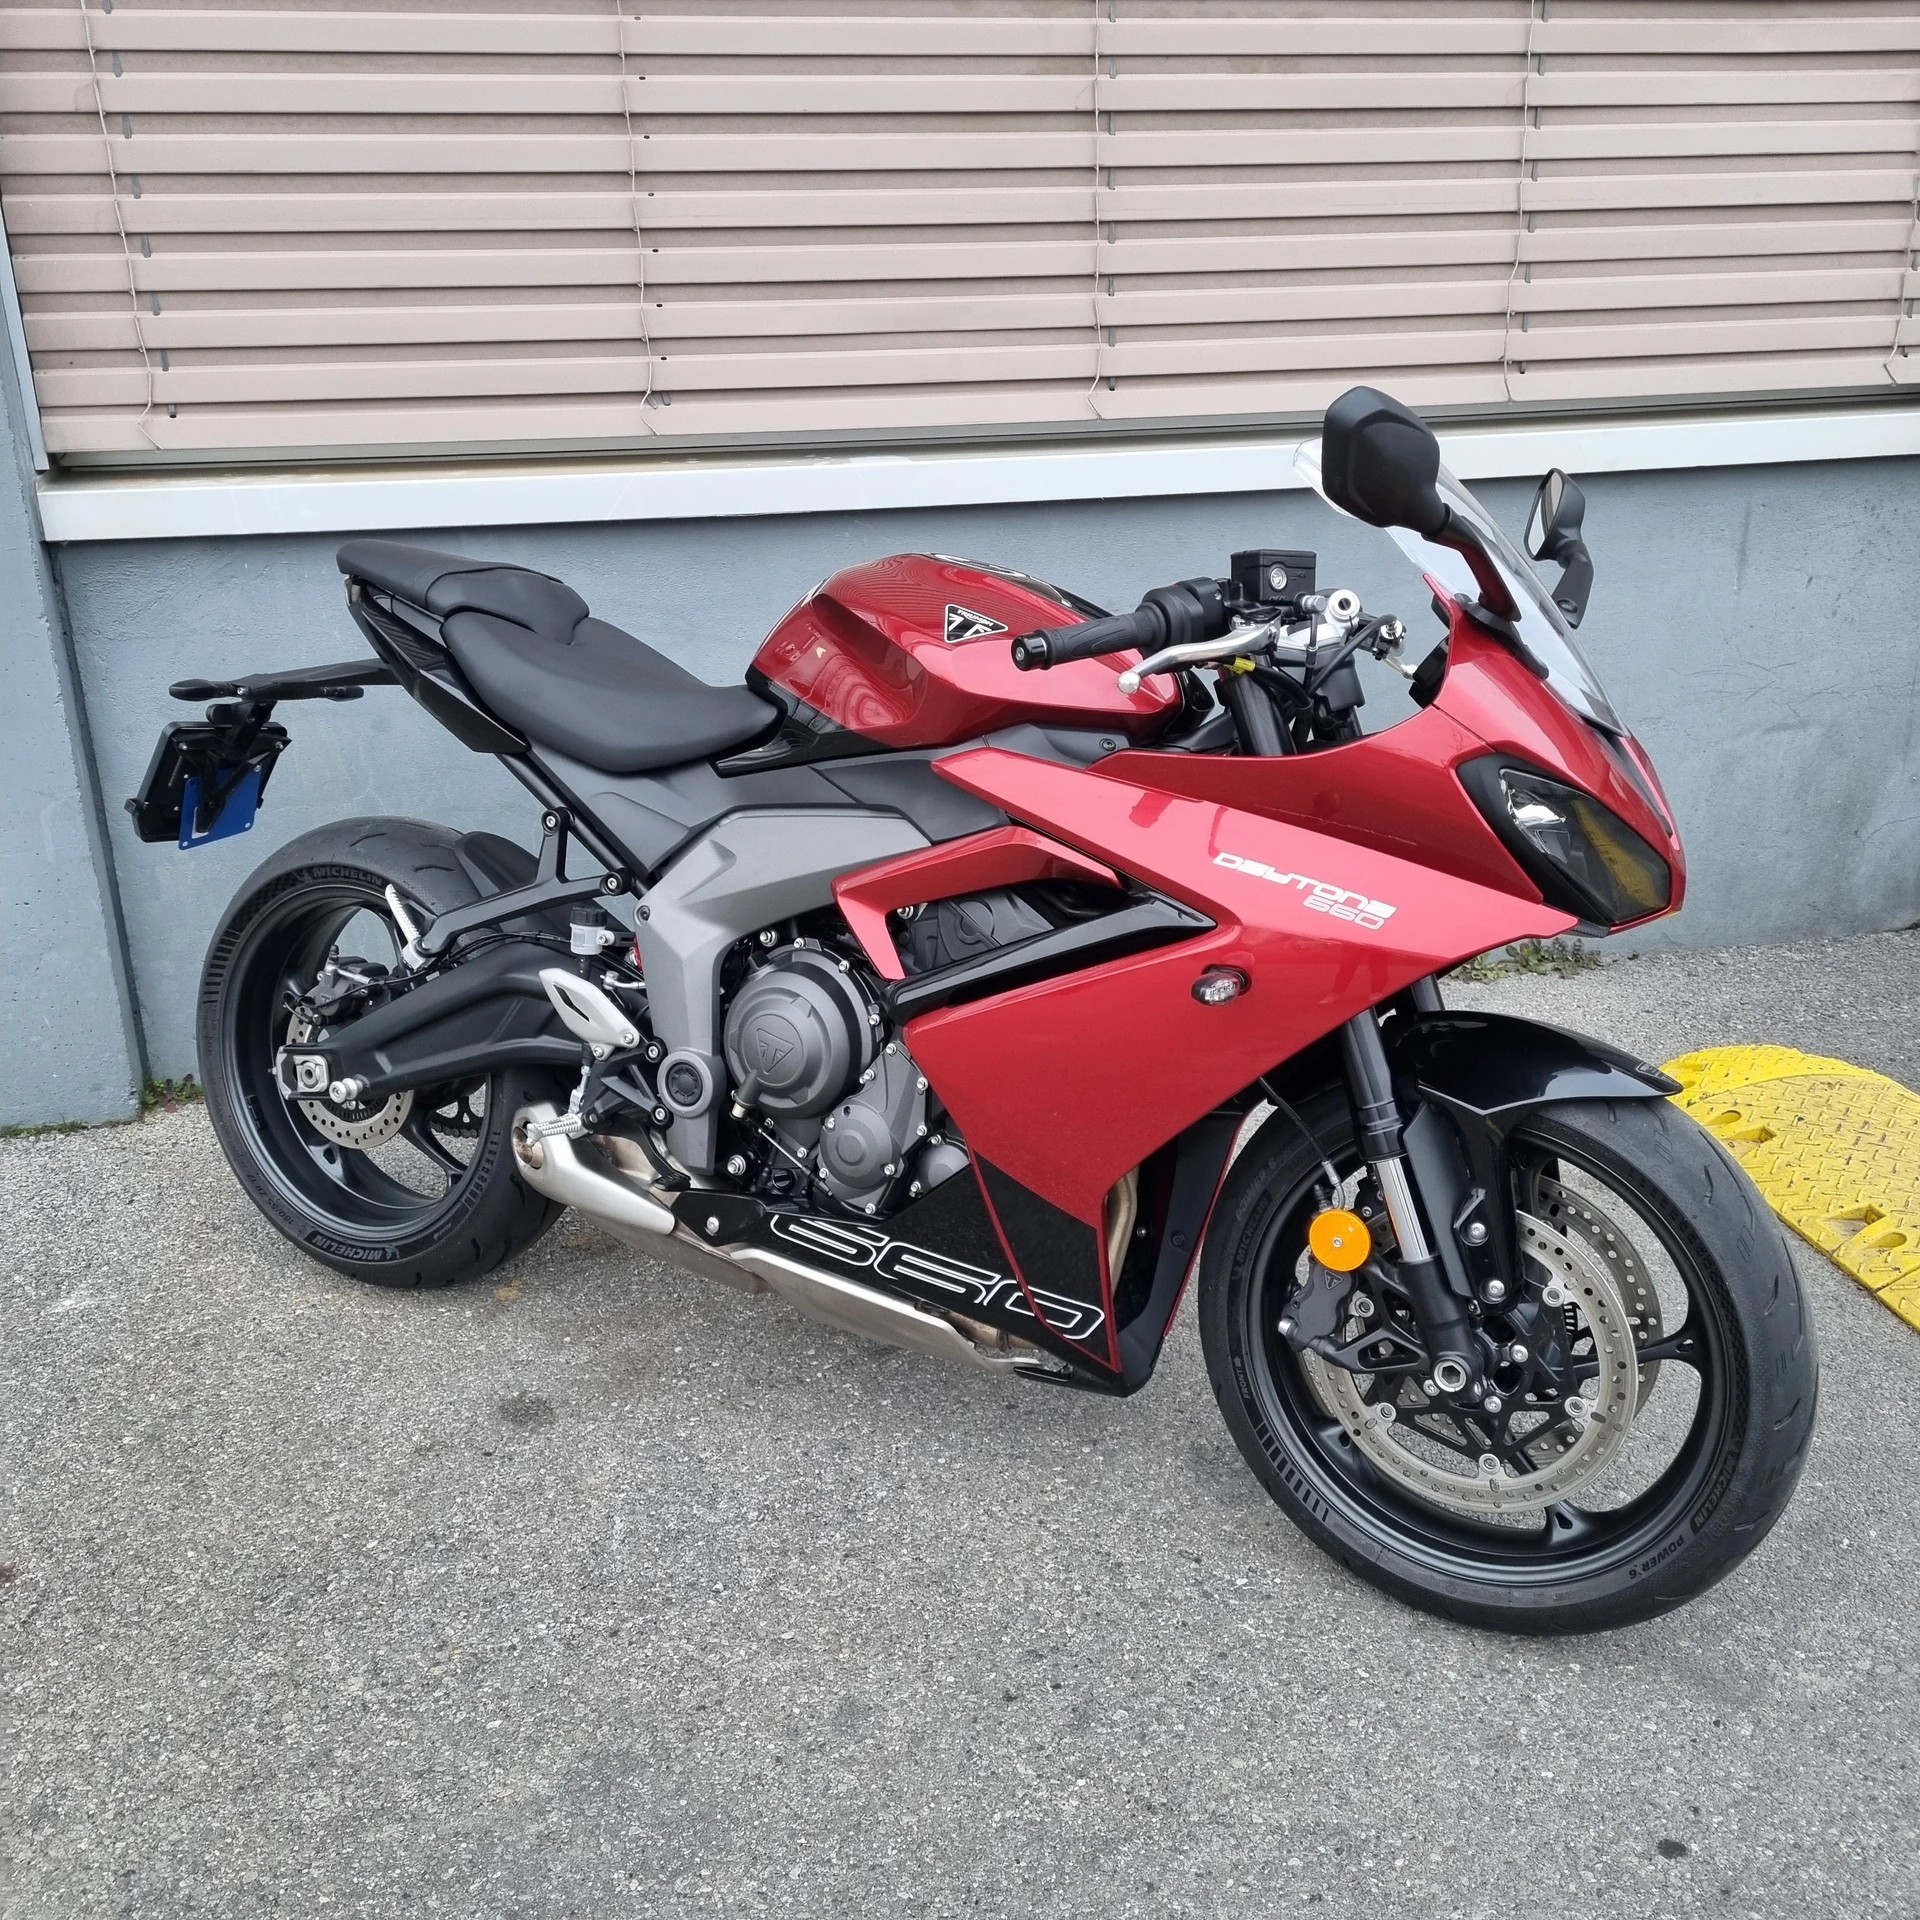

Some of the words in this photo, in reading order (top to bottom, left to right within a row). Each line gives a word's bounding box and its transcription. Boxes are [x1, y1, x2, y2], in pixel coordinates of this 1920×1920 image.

[956, 609, 994, 627] TRIUMPH
[313, 867, 383, 886] MICHELIN
[1303, 895, 1385, 930] 660
[266, 1198, 294, 1225] 180/55
[1236, 1195, 1269, 1263] MICHELIN
[312, 1235, 383, 1260] MICHELIN
[1236, 1368, 1251, 1399] FRONT
[1694, 1454, 1736, 1528] MICHELIN
[1642, 1535, 1685, 1573] POWER
[1628, 1568, 1638, 1580] 6
